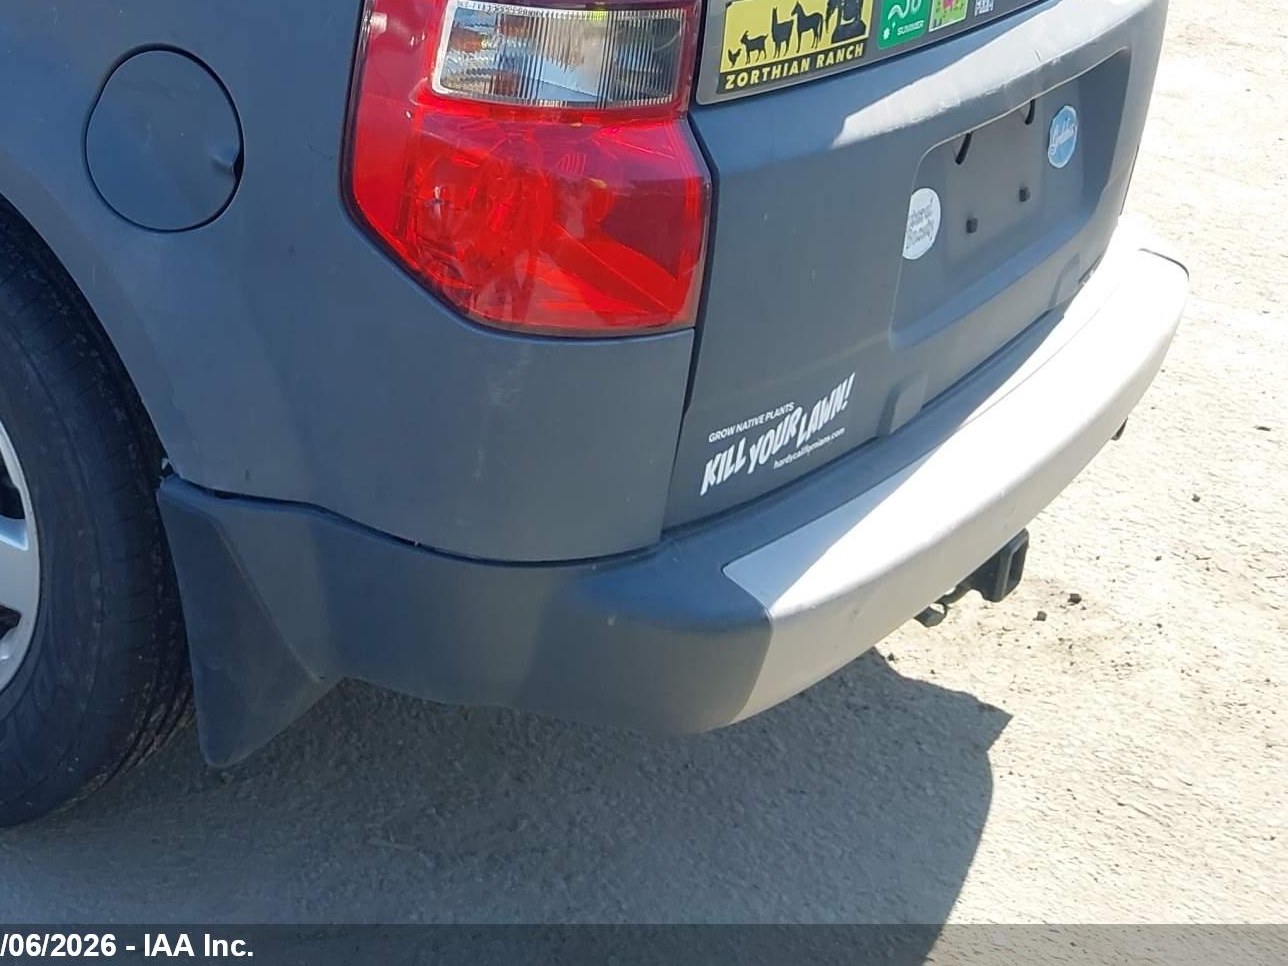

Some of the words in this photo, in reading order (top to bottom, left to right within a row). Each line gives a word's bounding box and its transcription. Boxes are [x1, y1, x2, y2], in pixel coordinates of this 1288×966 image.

[897, 19, 924, 35] SUMMER
[725, 57, 811, 90] ZORTHIAN
[816, 42, 864, 68] RANCH
[700, 437, 747, 496] KILL
[747, 406, 803, 475] YOUR
[796, 372, 855, 449] LAWN!
[709, 425, 736, 442] GROW
[736, 414, 765, 433] NATIVE
[765, 402, 795, 421] PLANTS
